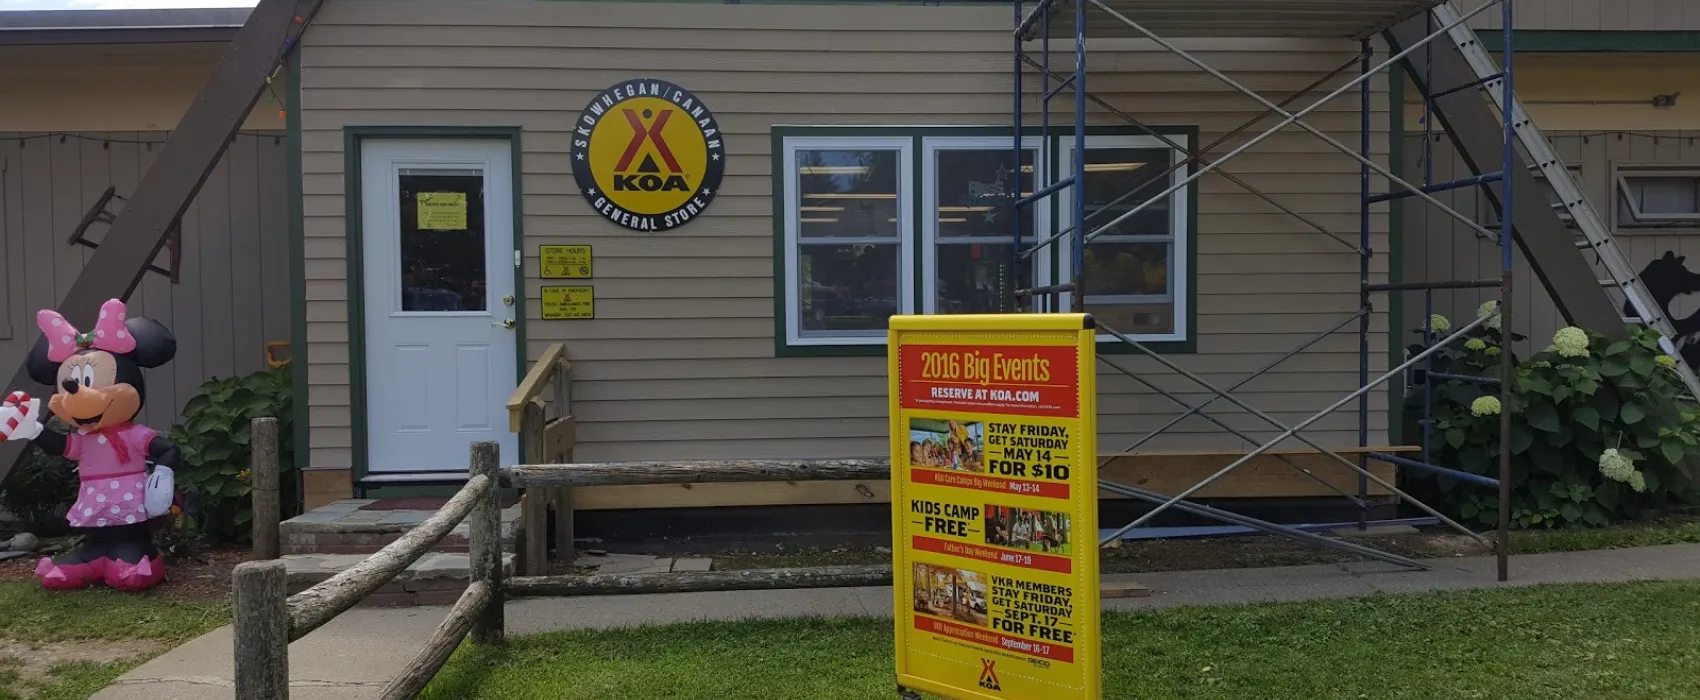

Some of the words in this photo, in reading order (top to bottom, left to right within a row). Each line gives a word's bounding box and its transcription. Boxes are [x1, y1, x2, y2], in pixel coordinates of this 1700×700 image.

[614, 174, 690, 192] KOA
[595, 197, 657, 230] GENERAL
[666, 197, 705, 227] STORE
[922, 353, 959, 379] 2016
[964, 350, 989, 385] Big
[994, 354, 1050, 381] Events
[932, 387, 973, 400] RESERVE
[975, 389, 987, 400] AT
[990, 389, 1039, 402] KOA.COM
[989, 423, 1016, 434] STAY
[1020, 424, 1069, 439] FRIDAY,
[989, 435, 1007, 445] GET
[1010, 436, 1068, 449] SATURDAY
[1004, 448, 1033, 461] MAY
[1037, 450, 1051, 461] 14
[989, 460, 1026, 476] FOR
[935, 473, 944, 481] KOA
[945, 474, 955, 483] Care
[957, 476, 972, 486] Camps
[974, 477, 982, 488] Big
[983, 478, 1006, 489] Weekend
[1010, 482, 1021, 492] May
[1022, 483, 1040, 492] 13-14
[912, 500, 940, 515] KIDS
[945, 504, 979, 520] CAMP
[944, 543, 964, 553] Father's
[965, 546, 974, 556] Day
[975, 548, 998, 560] Weekend
[1001, 552, 1014, 562] June
[992, 576, 1013, 587] VKR
[1016, 580, 1072, 596] MEMBERS
[992, 587, 1020, 598] STAY
[1024, 592, 1072, 609] FRIDAY,
[992, 597, 1011, 607] GET
[1014, 600, 1072, 618] SATURDAY
[993, 618, 1024, 634] FOR
[1005, 609, 1041, 624] SEPT.
[1045, 616, 1058, 626] 17
[933, 622, 943, 630] VKR
[944, 624, 974, 638] Appreciation
[975, 631, 998, 644] Weekend
[1002, 637, 1032, 651] September
[1033, 644, 1050, 654] 16-17
[979, 681, 1001, 691] KOA
